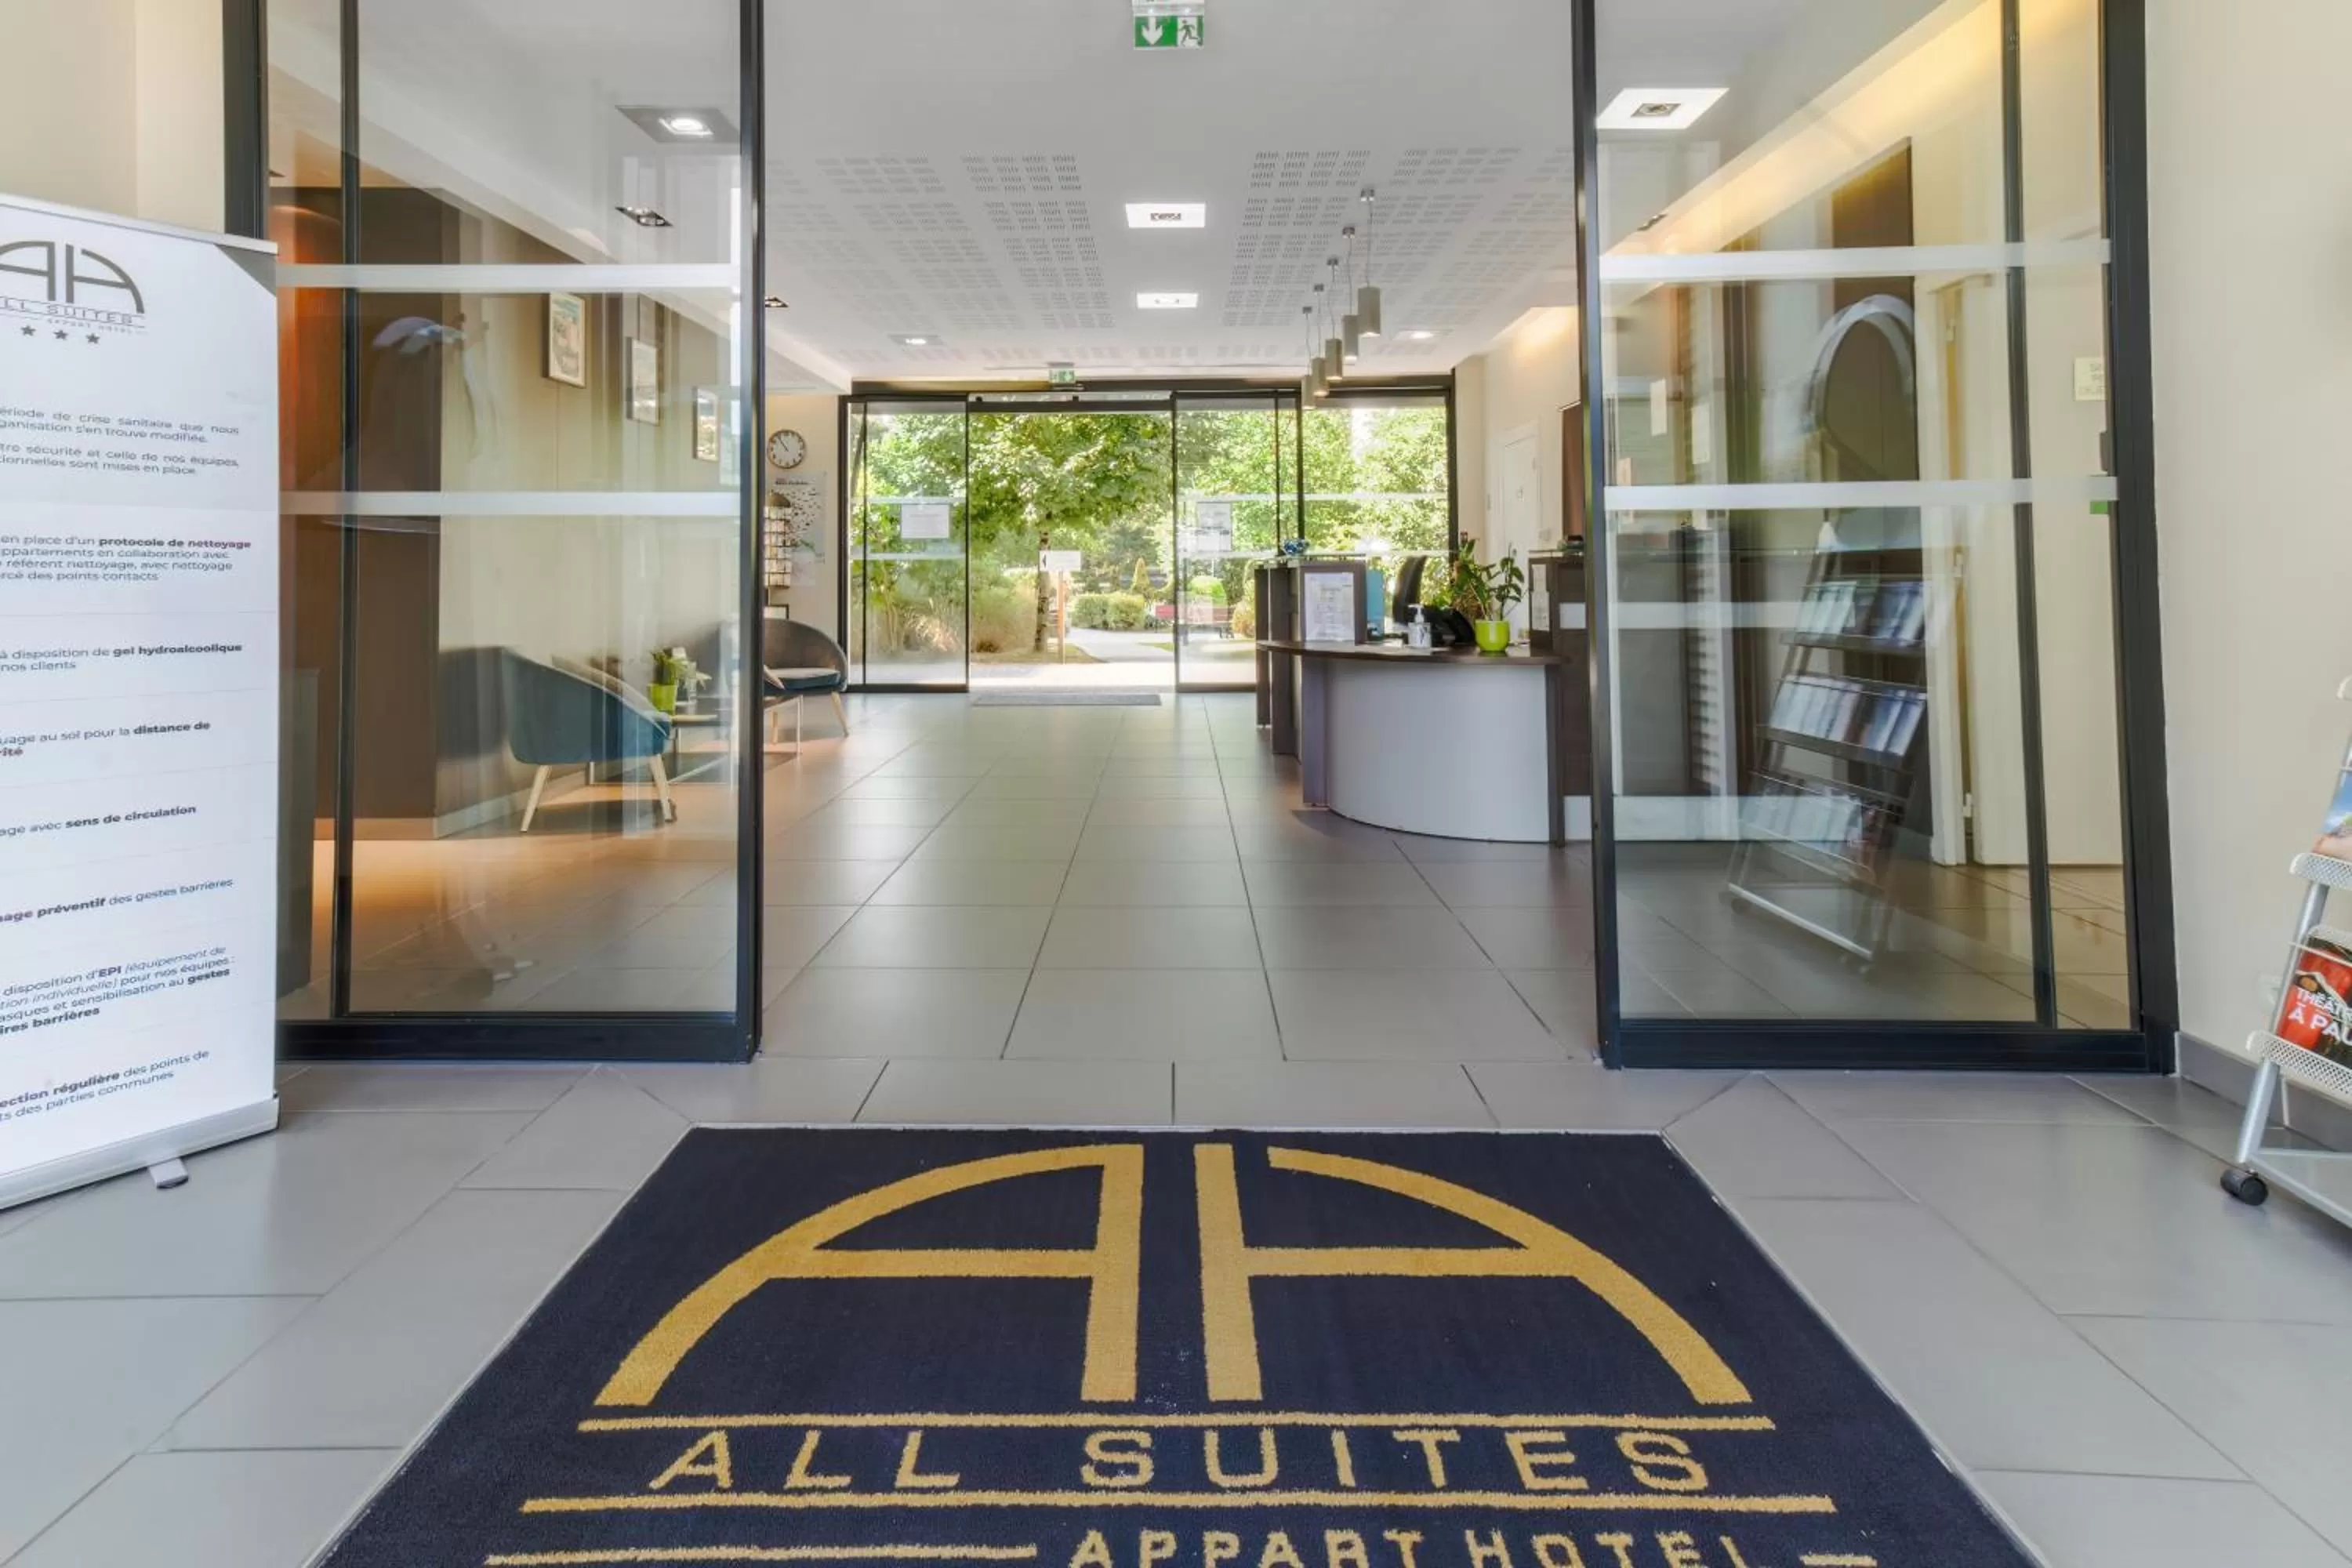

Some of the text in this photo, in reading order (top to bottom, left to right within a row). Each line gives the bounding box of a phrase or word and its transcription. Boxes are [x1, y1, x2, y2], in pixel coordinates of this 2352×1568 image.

[47, 303, 132, 324] SUITES
[53, 412, 71, 422] de
[79, 412, 111, 424] crise
[118, 416, 172, 429] sanitaire
[180, 422, 204, 432] que
[211, 425, 239, 434] nous
[105, 426, 147, 438] trouve
[0, 455, 66, 467] ionnelles
[68, 458, 99, 469] sont
[103, 459, 141, 471] mises
[143, 463, 160, 474] en
[27, 445, 82, 456] sécurité
[87, 448, 100, 458] et
[106, 450, 137, 461] celle
[141, 452, 158, 463] de
[163, 454, 187, 464] nos
[24, 534, 63, 547] place
[65, 535, 96, 546] d'un
[99, 536, 165, 548] protocole
[167, 538, 185, 547] de
[187, 539, 252, 550] nettoyage
[96, 549, 114, 558] en
[117, 550, 201, 560] collaboration
[202, 550, 232, 560] avec
[27, 570, 53, 581] des
[56, 571, 100, 583] points
[102, 572, 160, 583] contacts
[140, 561, 169, 571] avec
[172, 561, 234, 572] nettoyage
[12, 648, 89, 660] disposition
[92, 647, 111, 657] de
[112, 646, 136, 659] gel
[138, 643, 243, 655] hydroalcoolique
[0, 660, 77, 673] nos clients
[39, 733, 58, 743] au
[60, 729, 82, 742] sol
[83, 729, 116, 741] pour
[118, 726, 130, 736] la
[133, 724, 191, 735] distance
[193, 720, 212, 731] de
[30, 821, 63, 833] avec
[65, 816, 100, 829] sens
[103, 814, 122, 825] de
[125, 804, 198, 822] circulation
[37, 896, 107, 919] préventif
[108, 894, 133, 906] des
[135, 886, 178, 904] gestes
[180, 877, 234, 895] barrières
[3, 972, 83, 997] disposition
[209, 946, 227, 956] de
[120, 971, 151, 989] pour
[154, 967, 178, 979] nos
[53, 1000, 69, 1012] et
[71, 980, 165, 1008] sensibilisation
[169, 976, 185, 988] au
[187, 967, 230, 985] gestes
[32, 1007, 100, 1029] barrières
[53, 1071, 120, 1096] régulière
[123, 1065, 147, 1079] des
[150, 1054, 191, 1073] points
[192, 1049, 210, 1062] de
[15, 1105, 42, 1118] des
[46, 1091, 95, 1111] parties
[97, 1070, 175, 1097] communes
[648, 1428, 1711, 1492] ALL SUITES
[1068, 1527, 1750, 1568] APPART HOTEL
